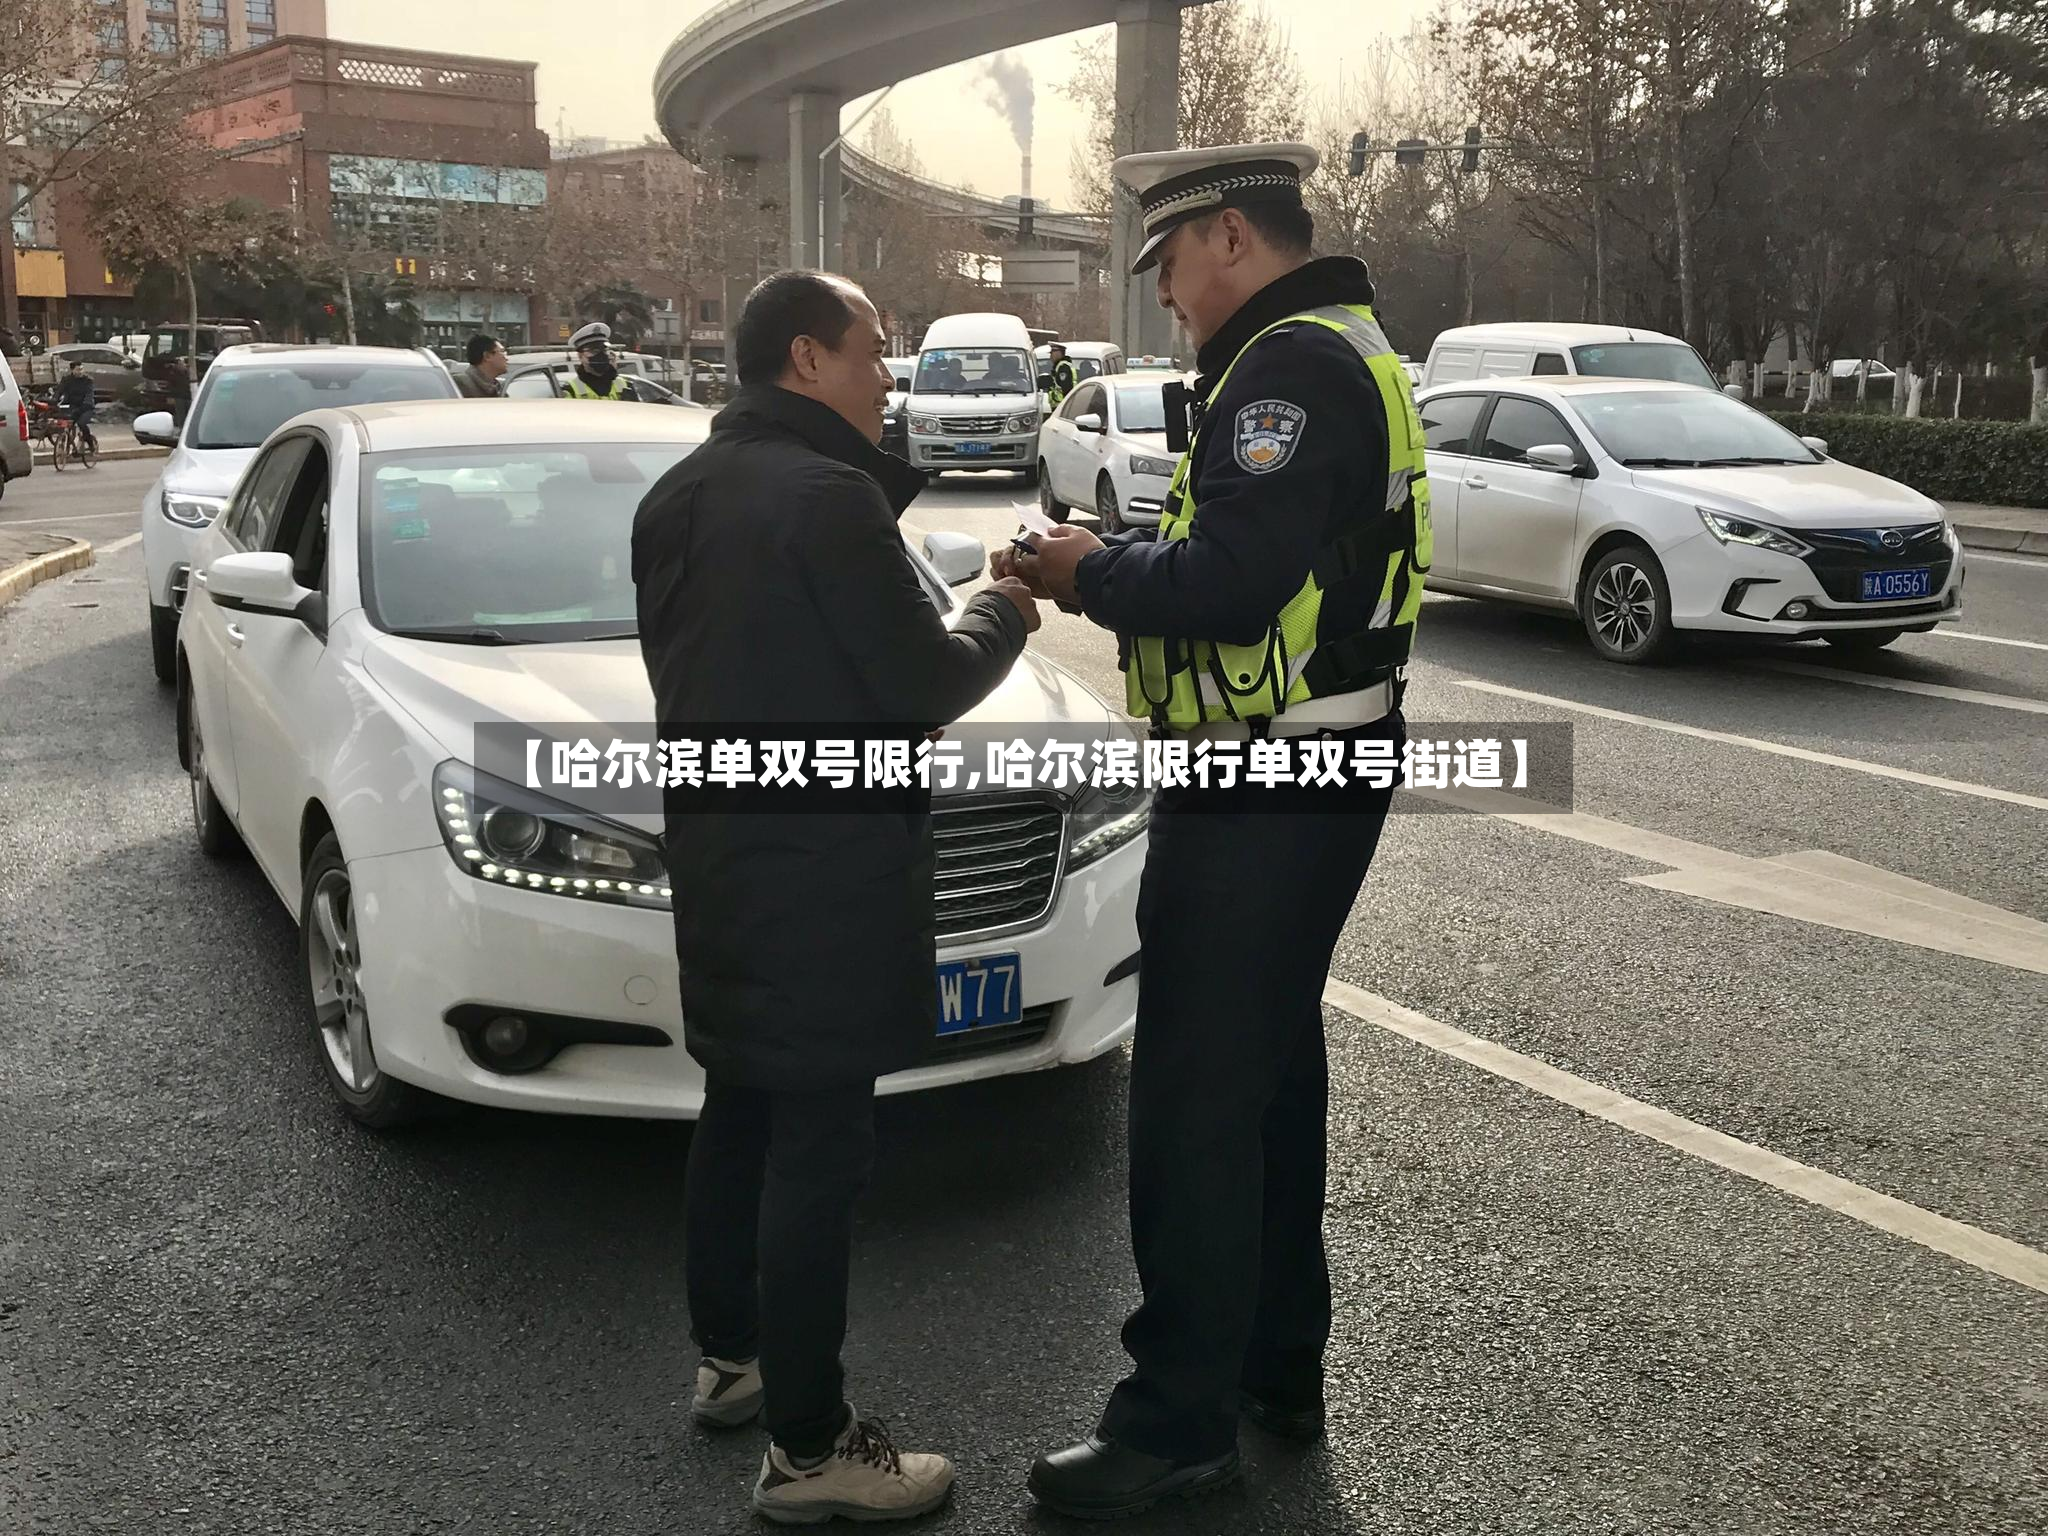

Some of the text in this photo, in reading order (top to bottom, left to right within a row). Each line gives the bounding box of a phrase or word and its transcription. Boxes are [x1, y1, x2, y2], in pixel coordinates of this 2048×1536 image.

[1241, 404, 1301, 421] 中华人民共和国
